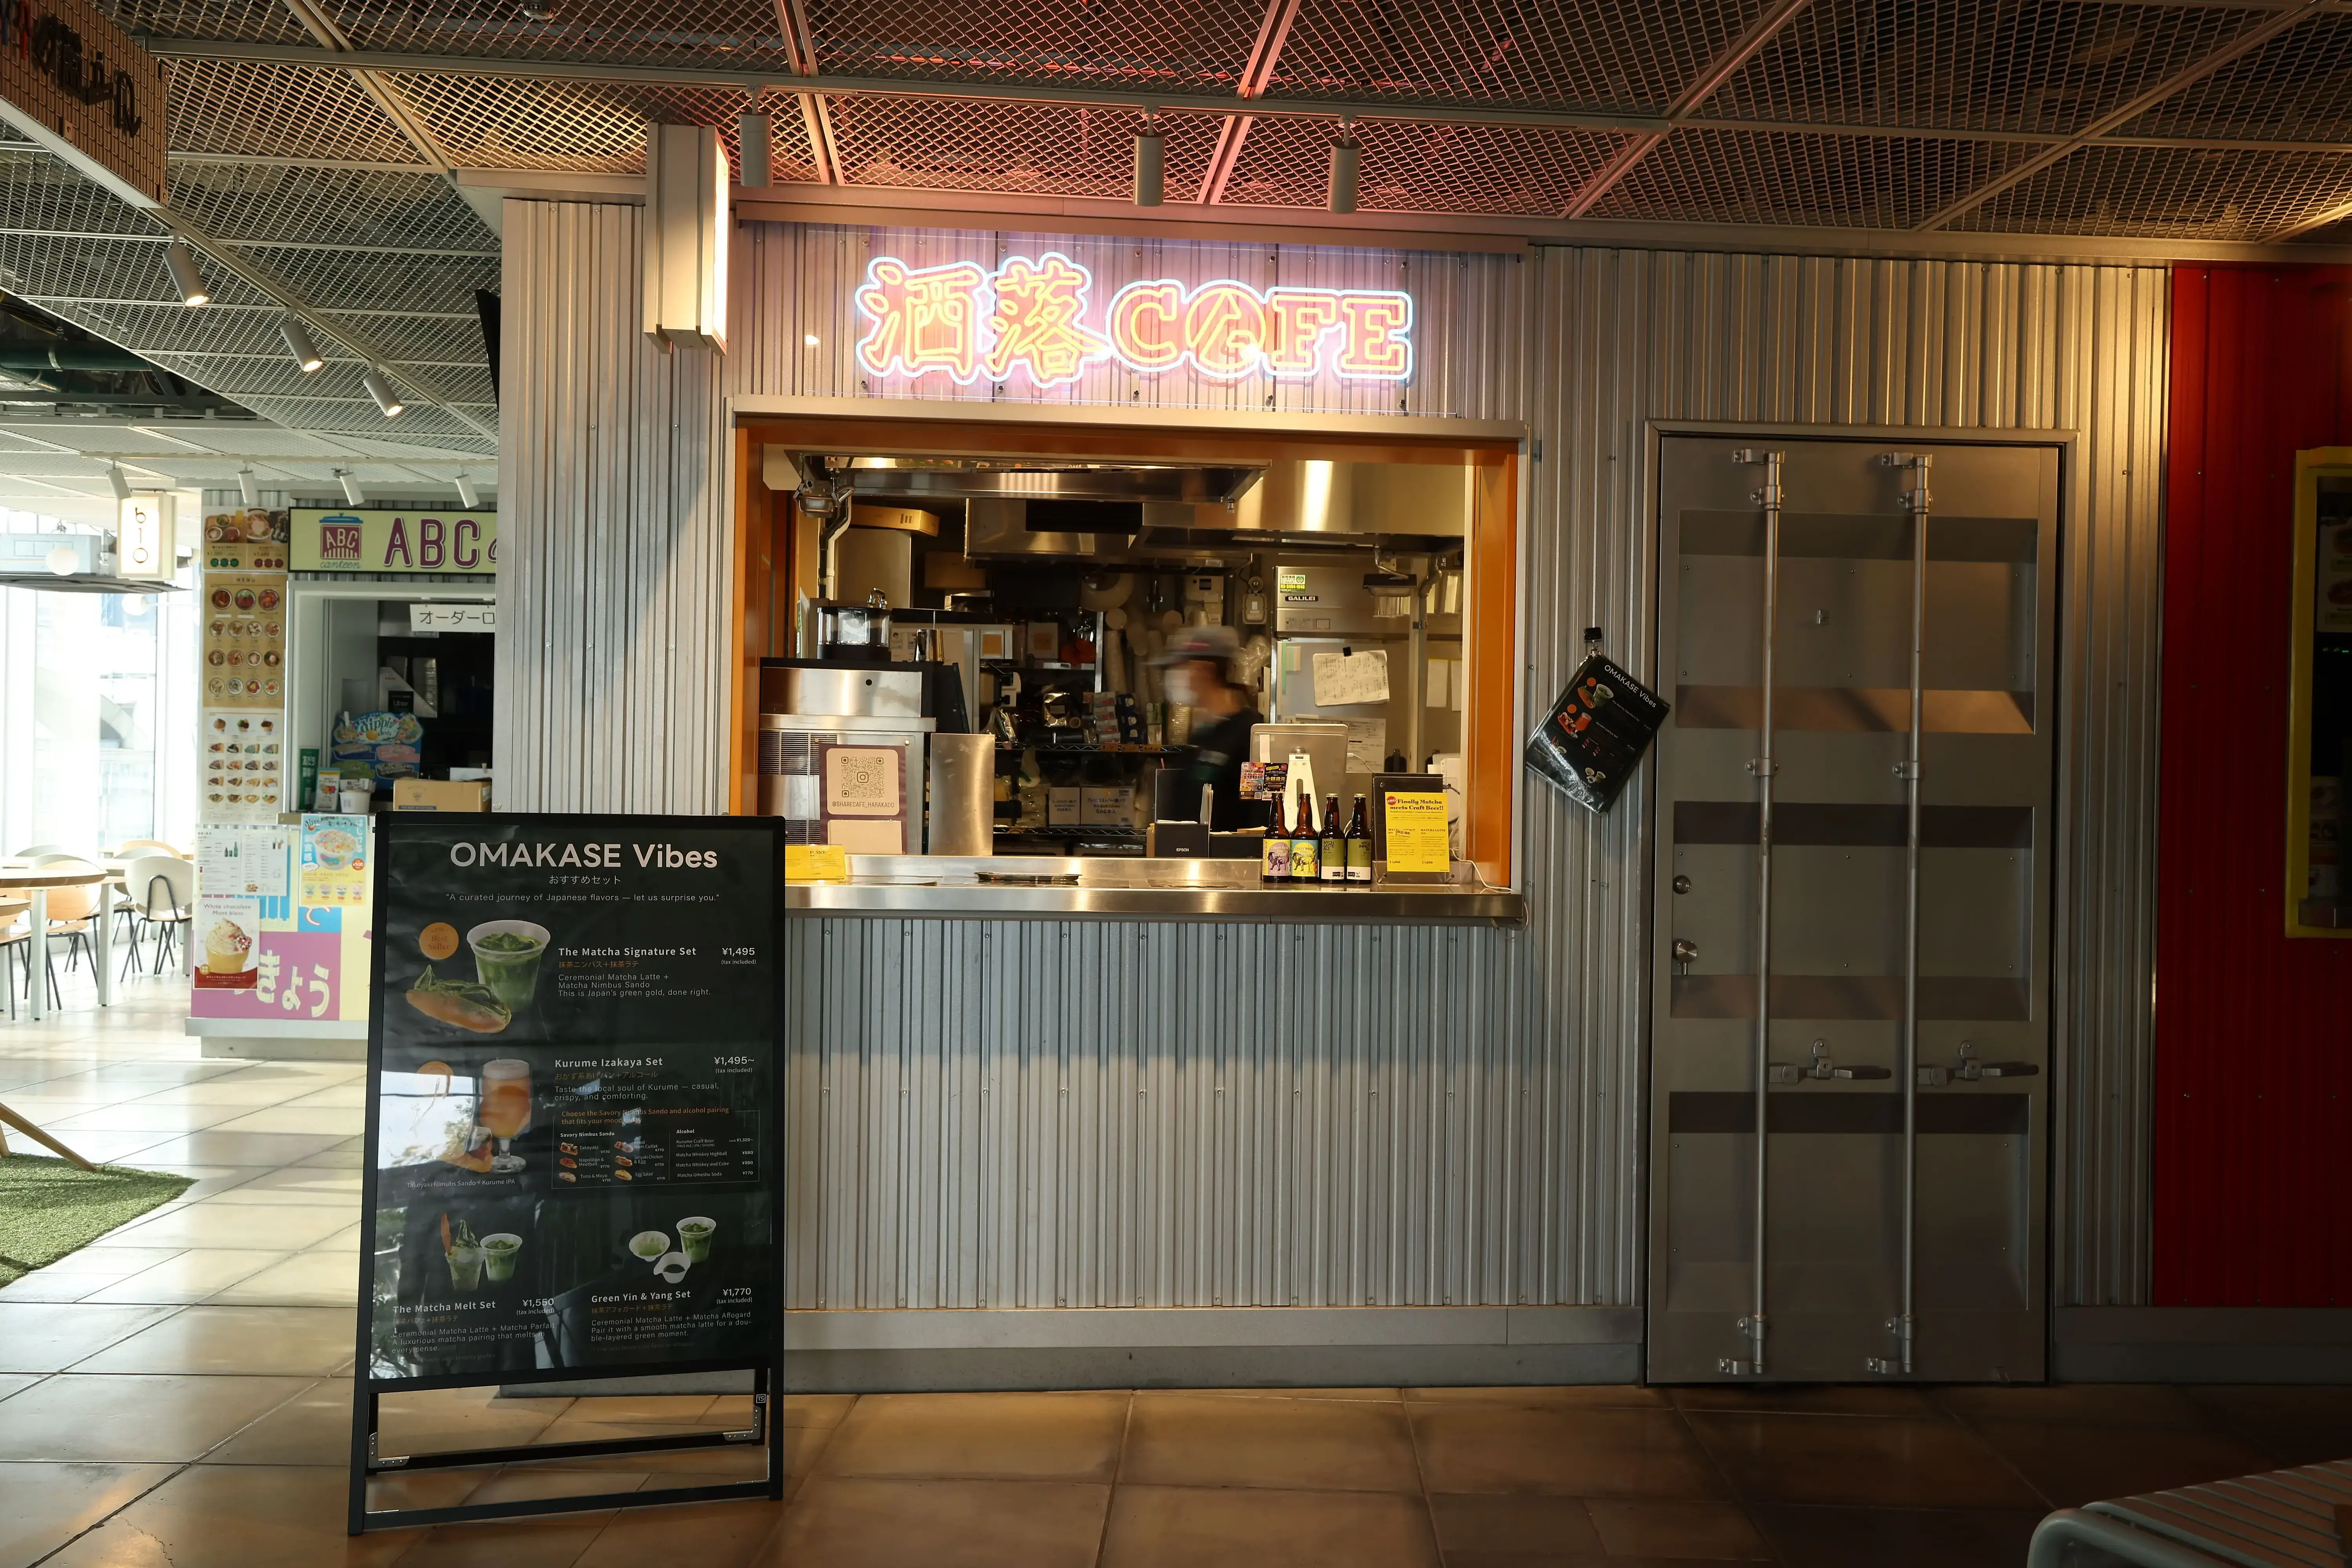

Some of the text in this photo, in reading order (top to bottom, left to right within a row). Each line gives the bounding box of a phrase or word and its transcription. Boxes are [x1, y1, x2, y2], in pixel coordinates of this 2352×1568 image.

[1105, 279, 1413, 381] CAFE
[326, 528, 358, 548] ABC
[383, 517, 480, 568] ABC
[320, 560, 361, 569] canteen
[1604, 665, 1657, 708] OMAKASE Vibes
[450, 843, 717, 868] OMAKASE Vibes
[496, 894, 530, 902] journey
[546, 894, 587, 902] Japanese
[558, 947, 696, 957] The Matcha Signature Set
[722, 947, 755, 956] ¥1,495
[234, 949, 329, 1018] きょう
[601, 1058, 642, 1067] Izakaya
[646, 1057, 663, 1066] Set
[622, 1293, 637, 1301] Yin
[650, 1292, 673, 1301] Yang
[722, 1288, 751, 1297] ¥1,770
[393, 1301, 496, 1314] The Matcha Melt Set
[522, 1298, 554, 1308] ¥1,550
